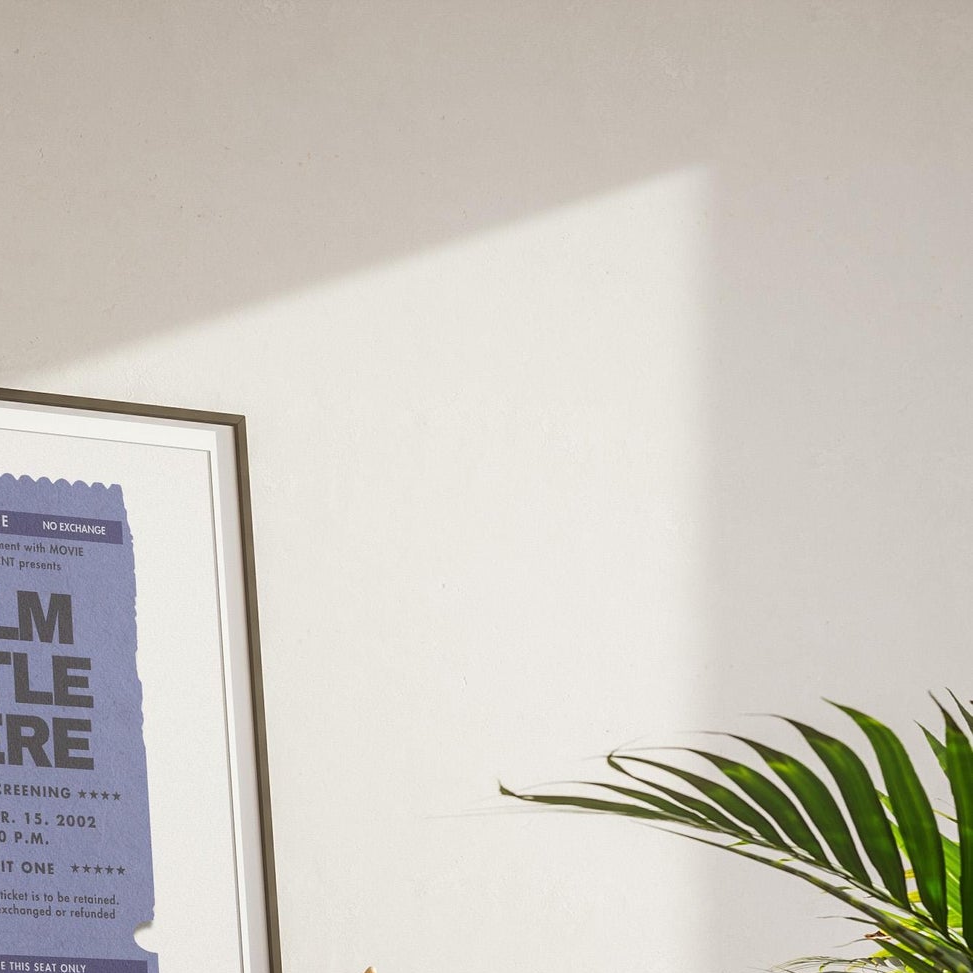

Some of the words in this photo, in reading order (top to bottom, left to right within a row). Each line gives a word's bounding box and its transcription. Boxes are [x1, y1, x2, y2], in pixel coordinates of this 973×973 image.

[42, 520, 57, 531] NO
[59, 522, 106, 535] EXCHANGE
[24, 542, 45, 553] with
[50, 544, 84, 557] MOVIE
[19, 560, 62, 571] presents
[24, 812, 49, 826] 15.
[56, 814, 97, 829] 2002
[14, 831, 50, 845] P.M.
[21, 861, 55, 875] ONE
[0, 889, 27, 901] ticket
[31, 891, 40, 901] is
[44, 892, 53, 902] to
[57, 891, 70, 902] be
[73, 894, 120, 905] retained.
[55, 909, 66, 917] or
[70, 907, 116, 919] refunded
[9, 961, 30, 972] THIS
[34, 962, 57, 973] SEAT
[60, 963, 86, 973] ONLY
